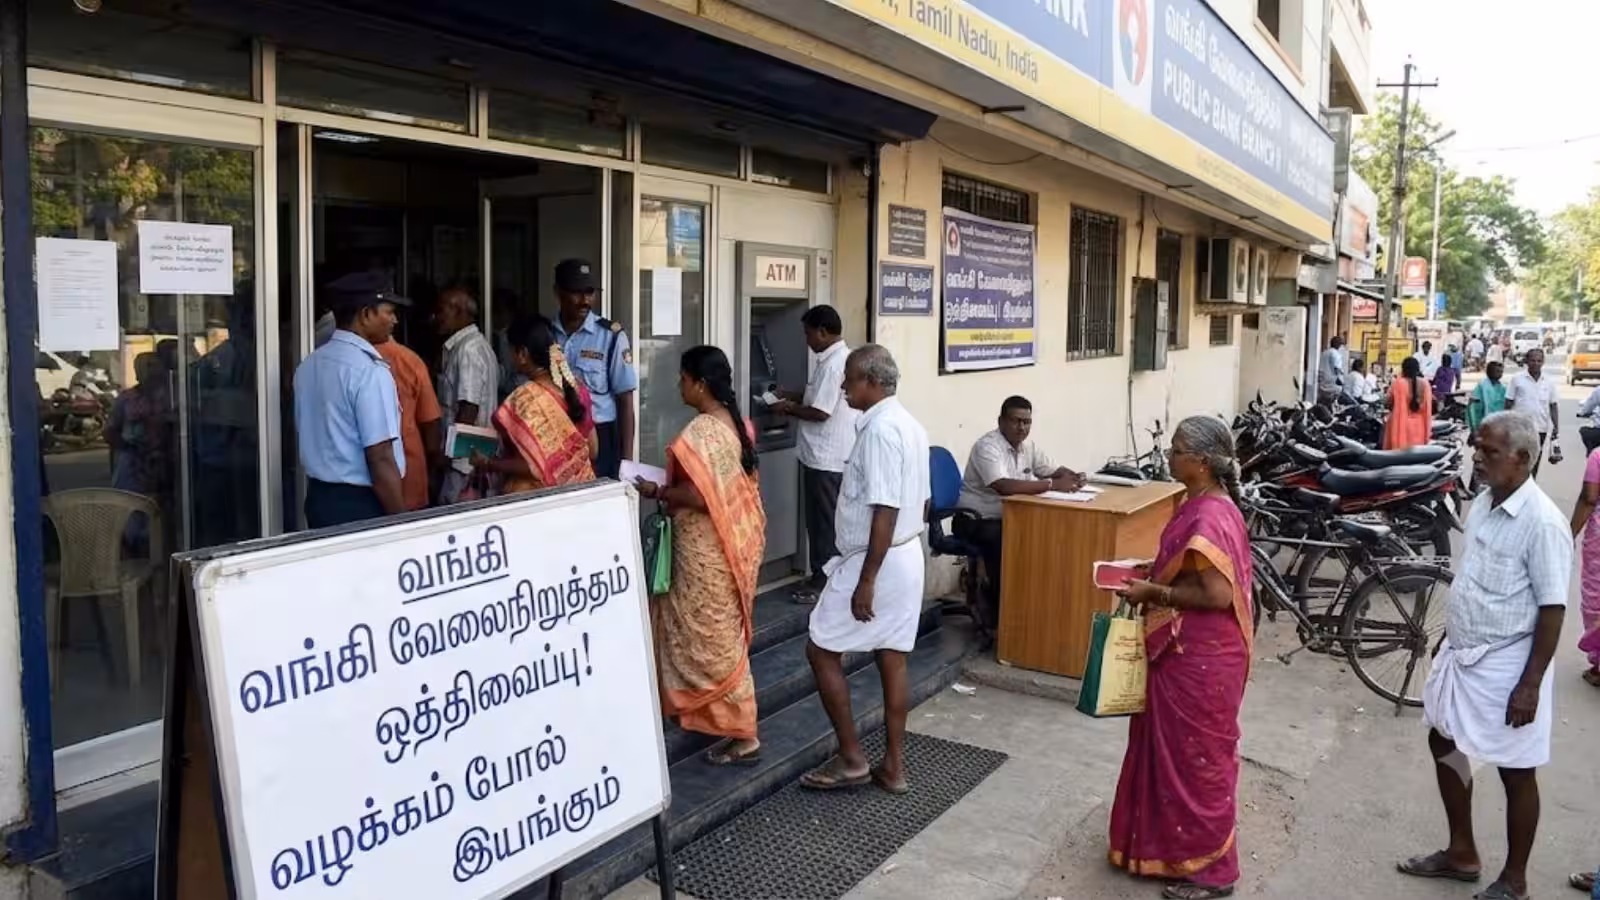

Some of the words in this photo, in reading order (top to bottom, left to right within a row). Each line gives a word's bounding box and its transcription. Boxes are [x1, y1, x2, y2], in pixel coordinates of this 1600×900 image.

[907, 0, 953, 39] Tamil
[958, 14, 1001, 68] Nadu,
[1005, 41, 1039, 83] India
[1163, 59, 1211, 123] PUBLIC
[1212, 96, 1241, 147] BANK
[765, 263, 797, 282] ATM
[398, 524, 510, 595] வங்கி
[239, 623, 378, 714] வங்கி
[388, 554, 631, 665] வேலைநிறுத்தம்
[375, 632, 594, 765] ஒத்திவைப்பு!
[270, 770, 456, 892] வழக்கம்
[465, 724, 568, 802] போல்
[452, 765, 621, 883] இயங்கும்
